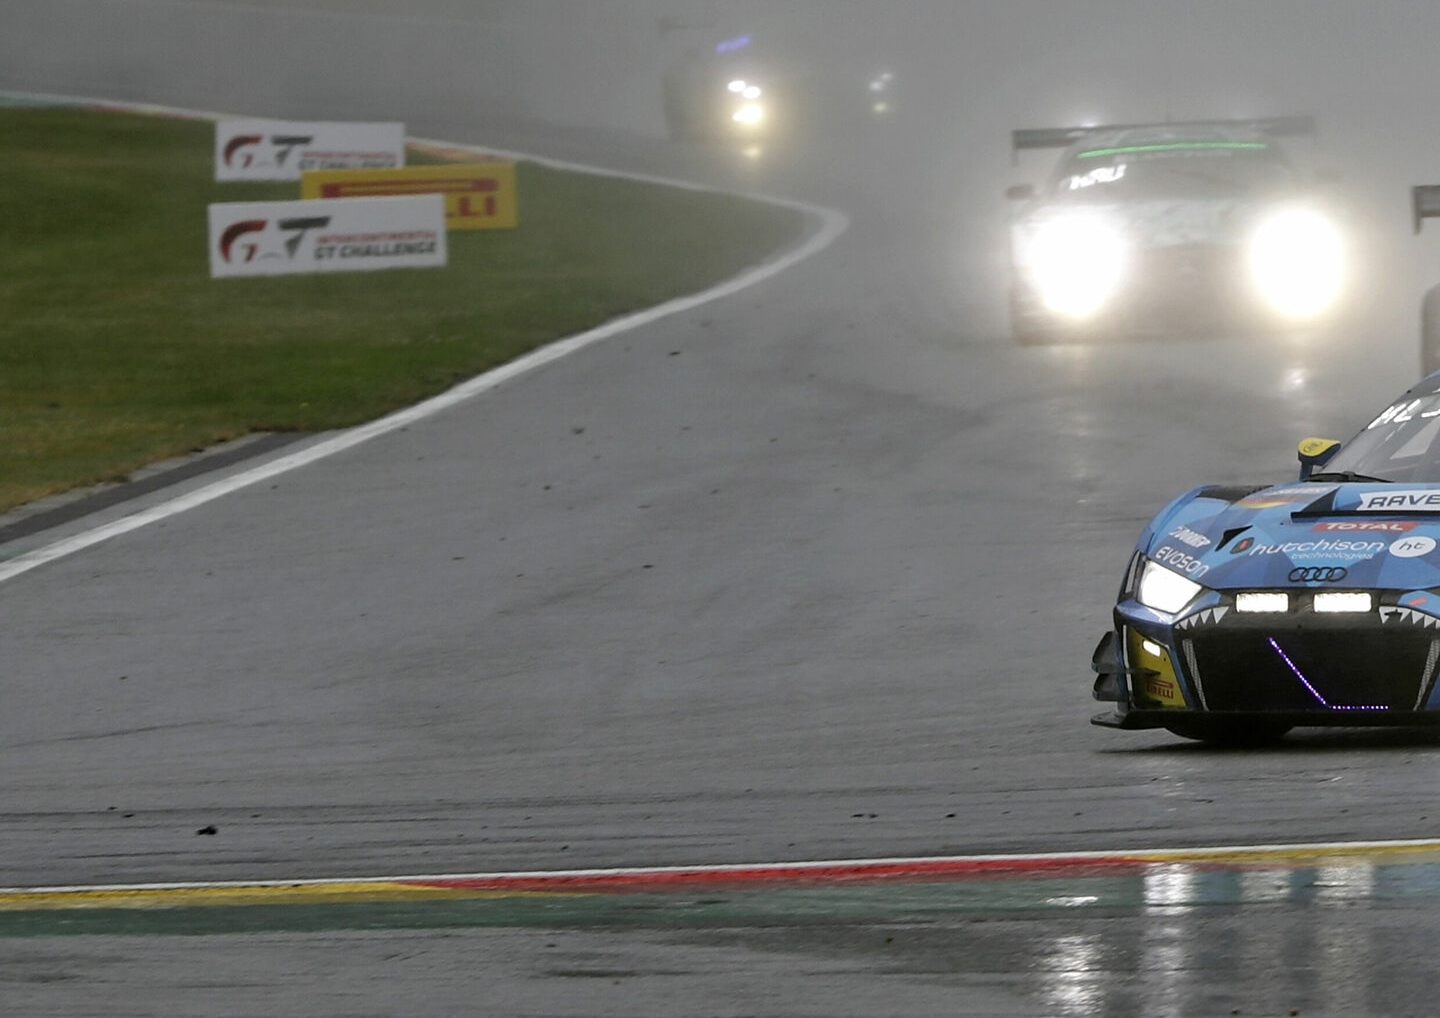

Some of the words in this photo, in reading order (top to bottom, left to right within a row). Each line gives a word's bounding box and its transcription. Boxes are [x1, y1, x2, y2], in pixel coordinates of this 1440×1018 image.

[339, 241, 436, 258] CHALLENGE
[1327, 522, 1404, 531] TOTAL
[1250, 538, 1385, 557] hutchison
[1291, 551, 1374, 560] technologies
[1155, 546, 1210, 578] EVOSON
[1147, 678, 1174, 699] PIRELLI
